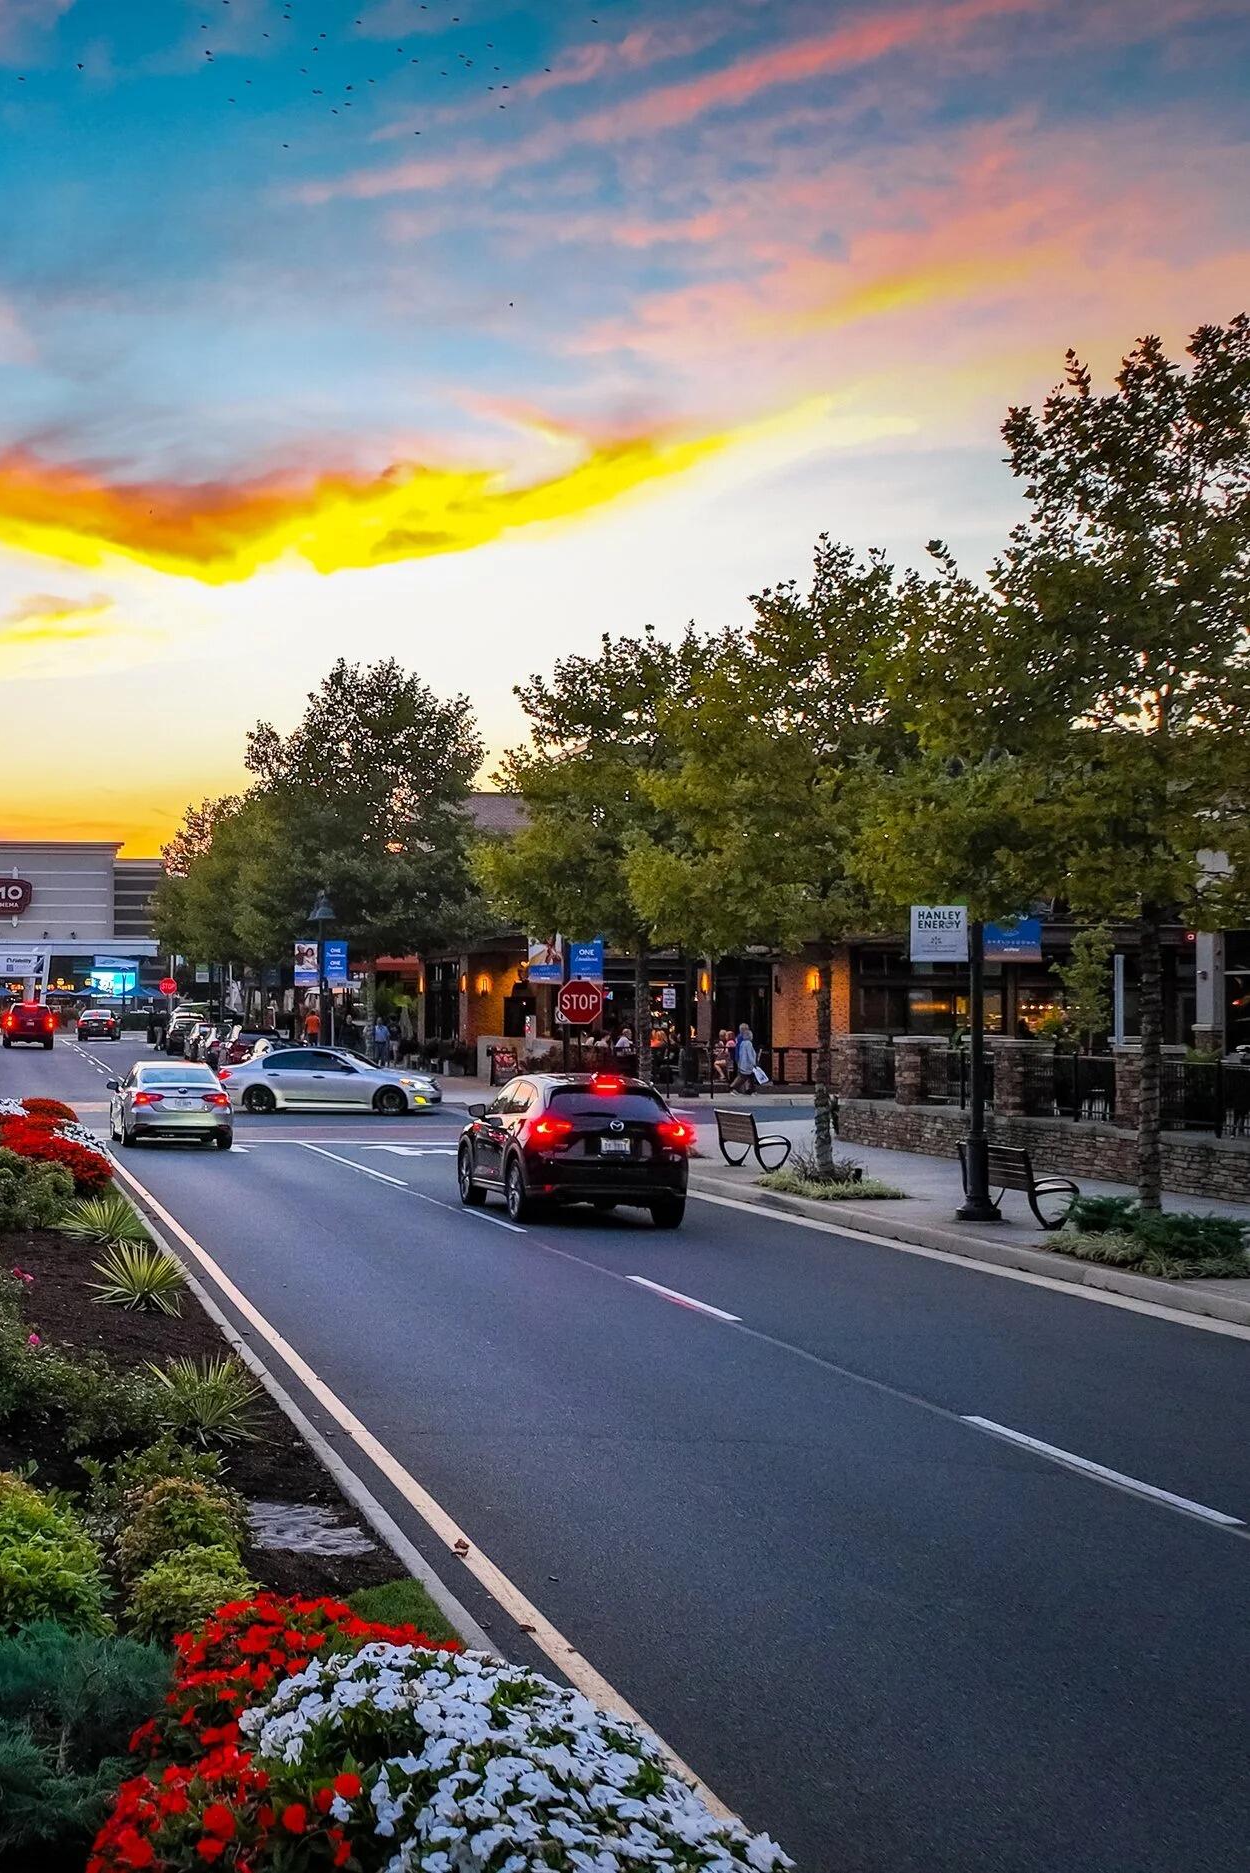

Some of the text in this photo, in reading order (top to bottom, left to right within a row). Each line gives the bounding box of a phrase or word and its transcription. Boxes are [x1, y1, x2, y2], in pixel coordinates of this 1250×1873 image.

[918, 911, 961, 920] HANLEY
[918, 920, 961, 929] ENERGY
[561, 994, 598, 1010] STOP
